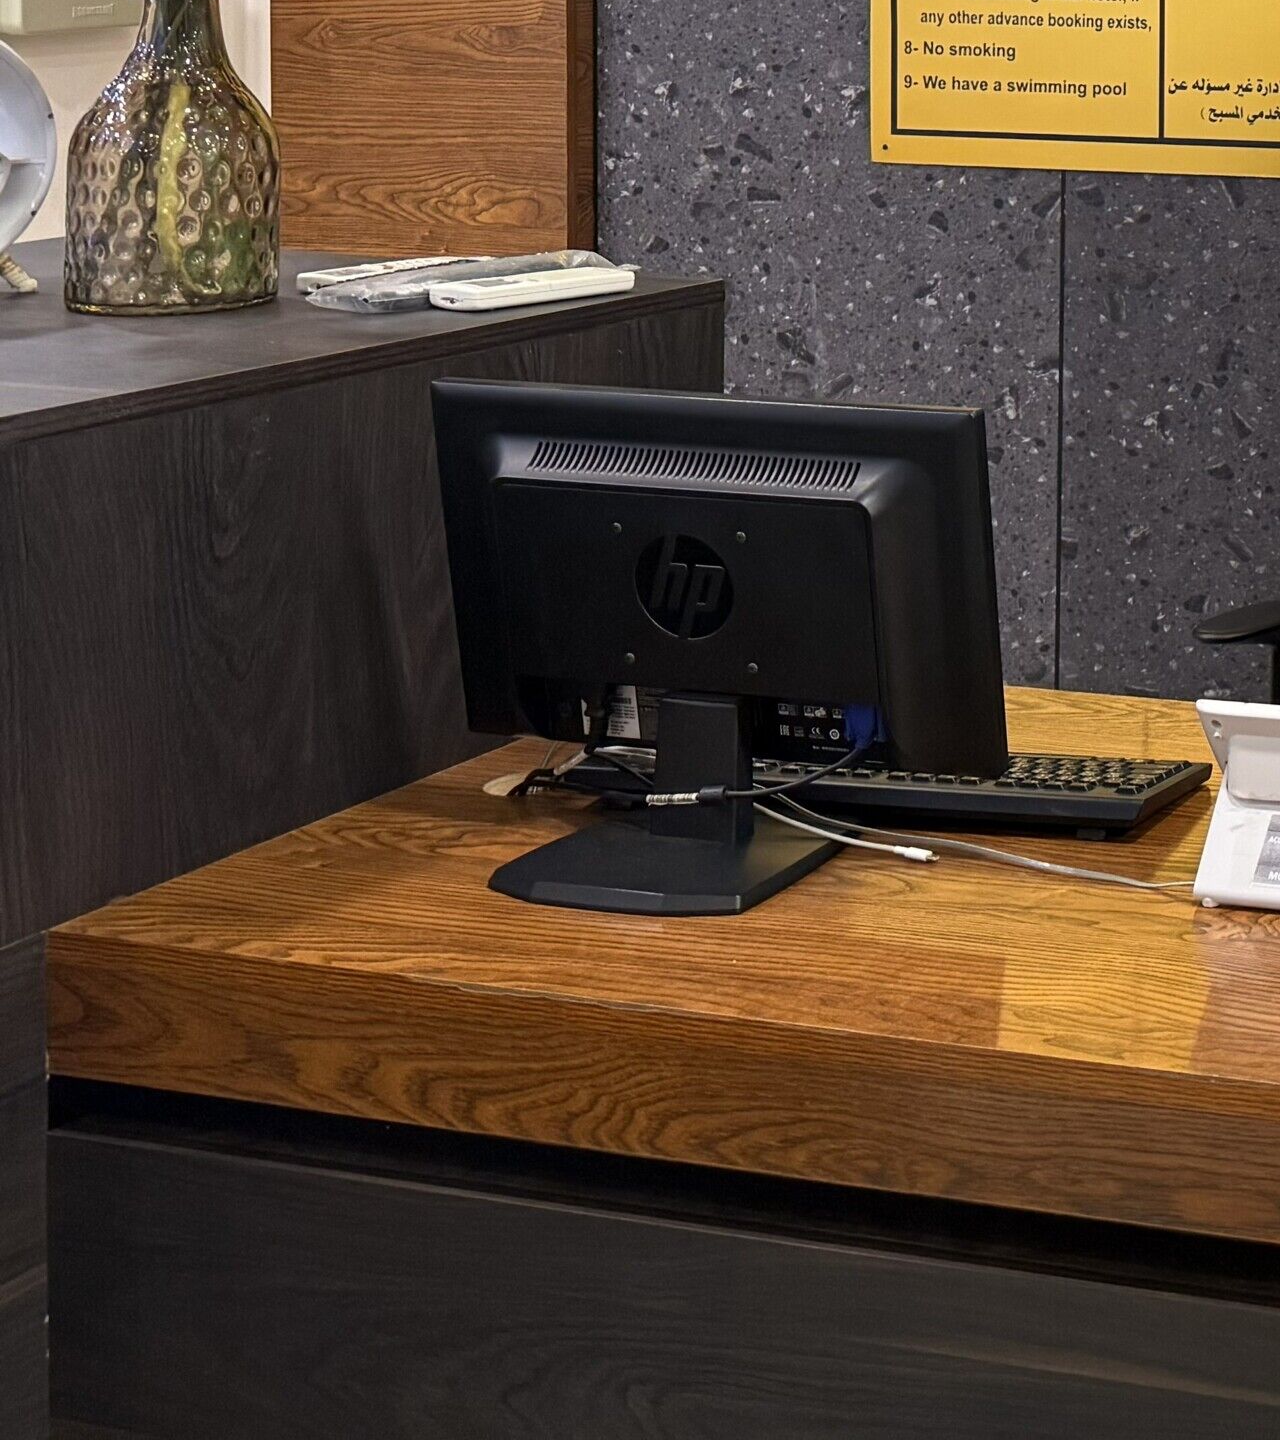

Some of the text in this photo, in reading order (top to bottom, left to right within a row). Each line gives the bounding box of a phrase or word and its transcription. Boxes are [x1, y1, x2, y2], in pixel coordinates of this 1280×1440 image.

[920, 11, 1152, 33] any other advance booking exists,
[923, 40, 945, 56] No
[948, 42, 1016, 62] smoking
[922, 74, 947, 90] We
[951, 75, 989, 92] have
[992, 80, 1002, 92] a
[1006, 78, 1088, 99] swimming
[1092, 81, 1127, 99] pool
[647, 532, 729, 639] hp
